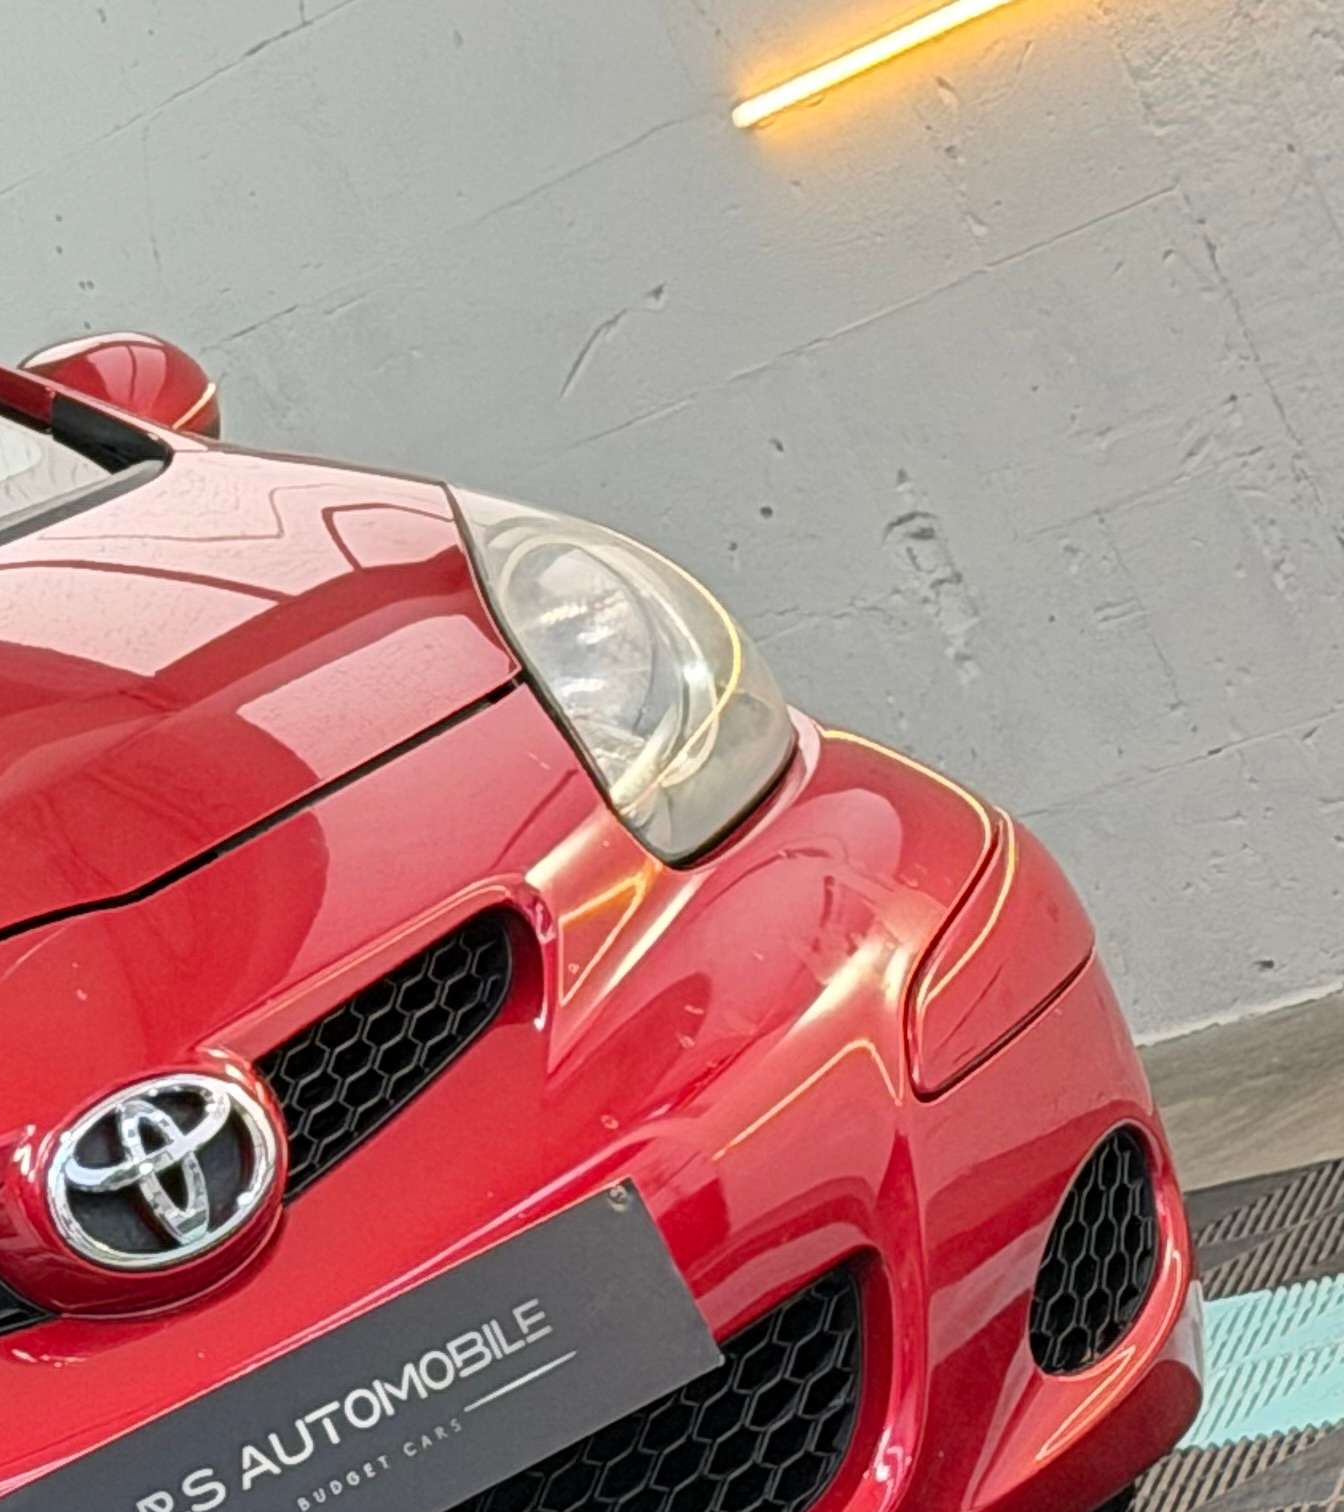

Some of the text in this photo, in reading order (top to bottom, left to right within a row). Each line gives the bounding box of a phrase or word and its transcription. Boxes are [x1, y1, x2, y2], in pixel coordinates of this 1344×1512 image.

[242, 1298, 553, 1490] AUTOMOBILE
[297, 1454, 393, 1512] BUDGET
[403, 1418, 464, 1458] CARS
